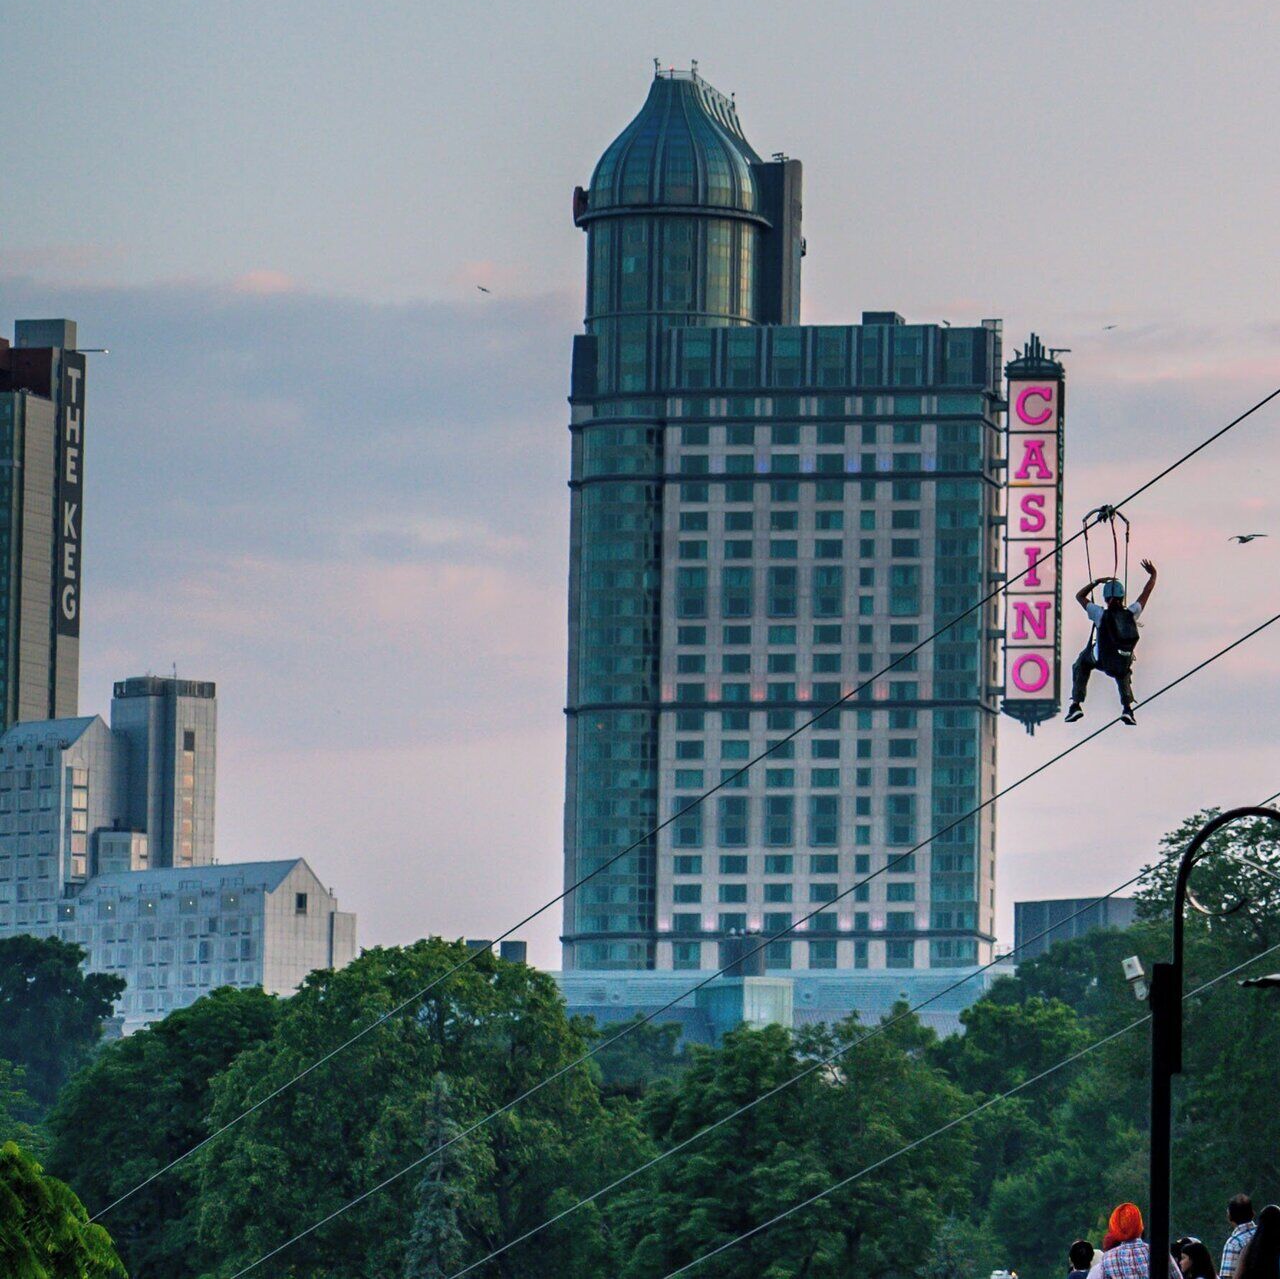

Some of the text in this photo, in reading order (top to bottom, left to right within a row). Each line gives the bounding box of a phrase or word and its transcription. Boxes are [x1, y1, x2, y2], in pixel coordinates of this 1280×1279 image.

[62, 367, 81, 620] THE KEG
[1012, 386, 1053, 692] CASINO
